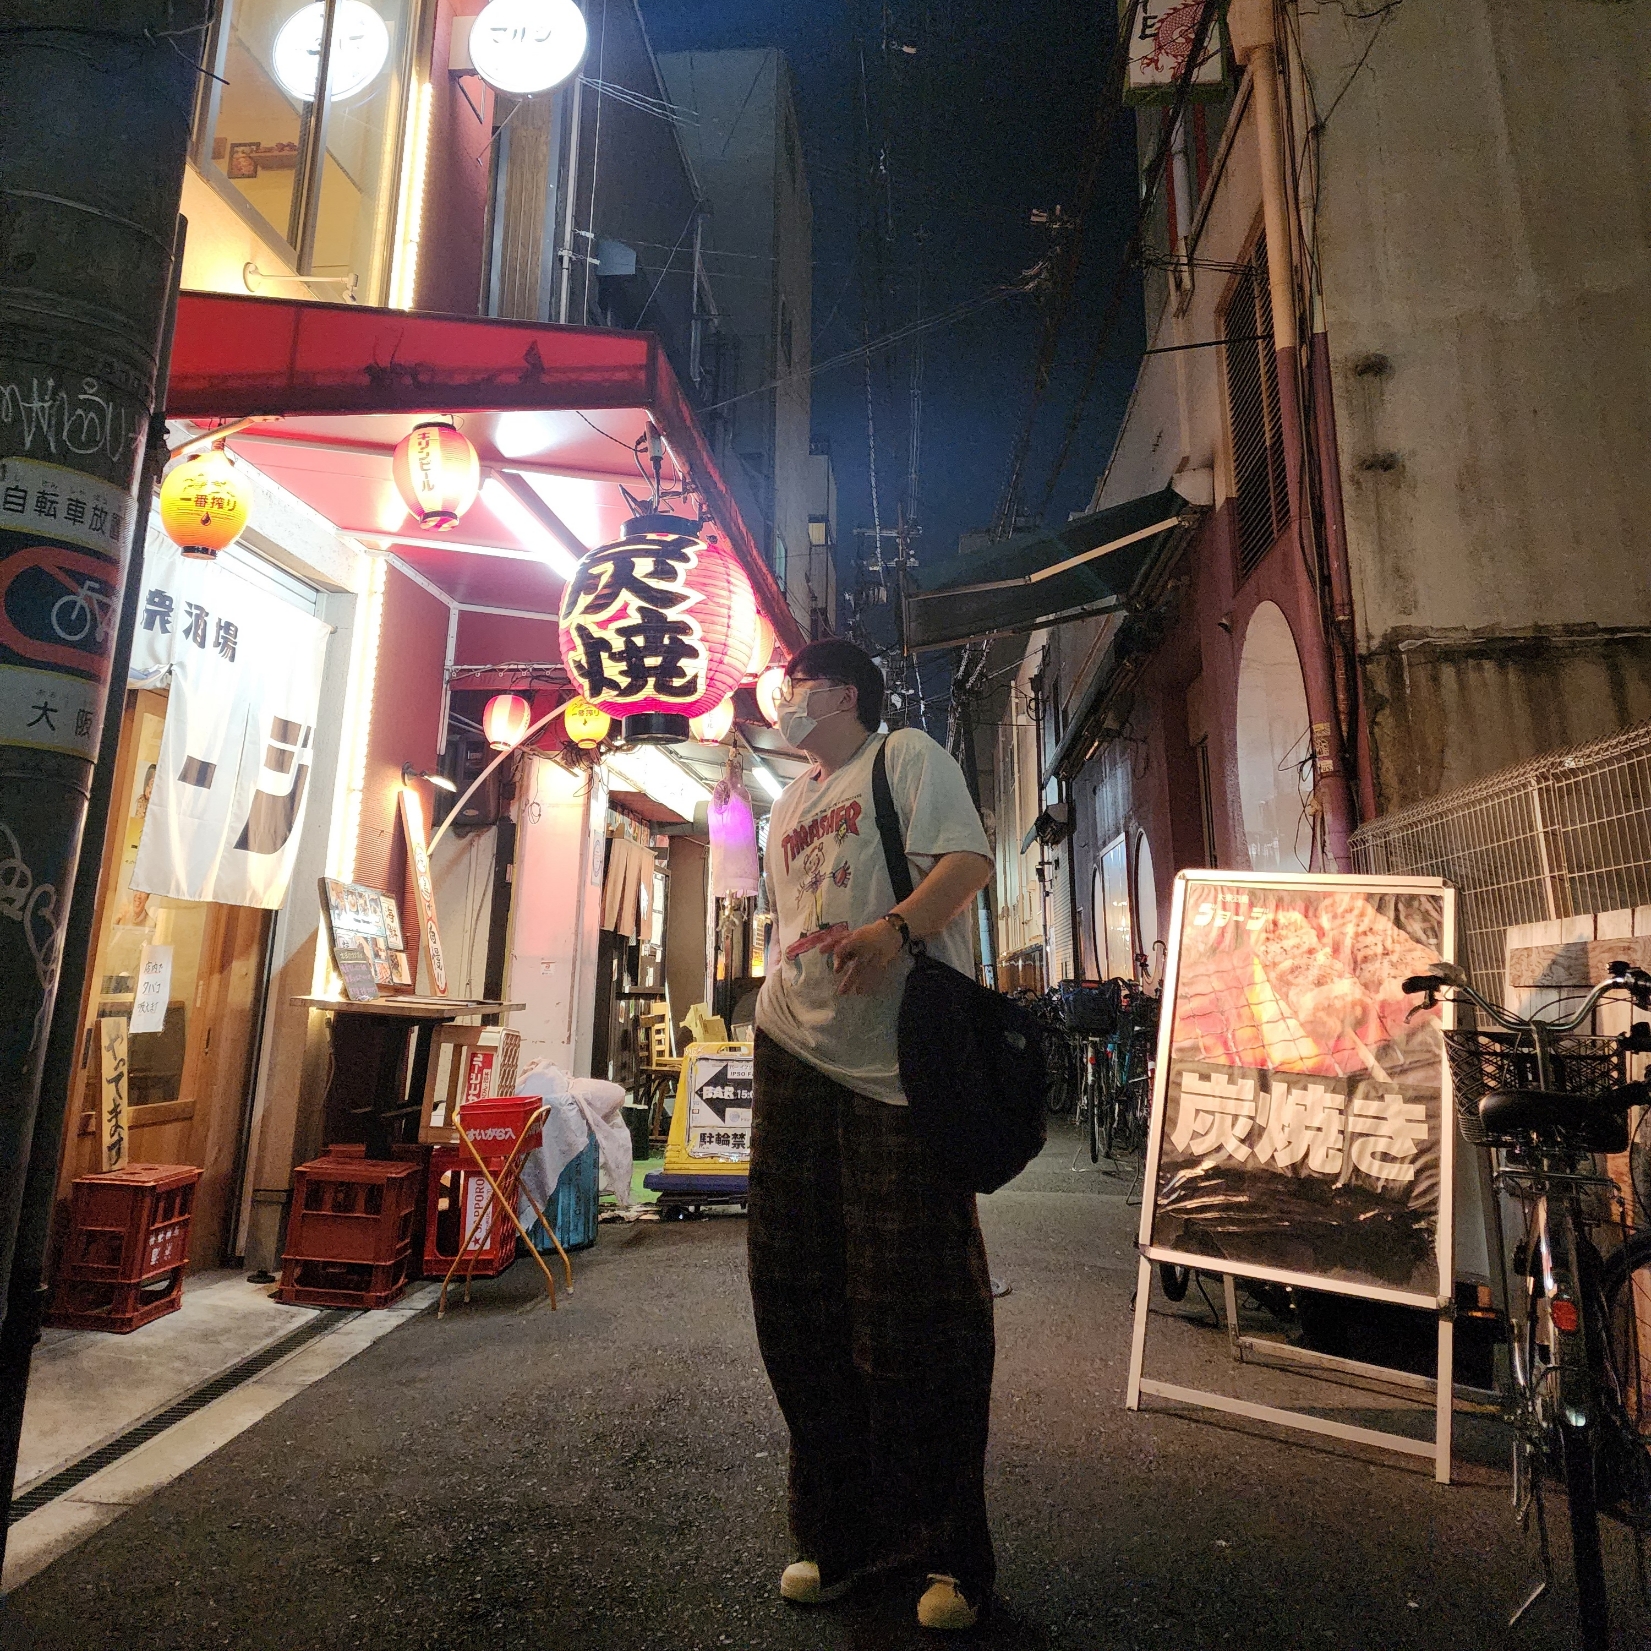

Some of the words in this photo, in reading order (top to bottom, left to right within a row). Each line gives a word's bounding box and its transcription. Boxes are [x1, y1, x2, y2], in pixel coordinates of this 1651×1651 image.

[179, 494, 237, 512] 一番搾り
[781, 800, 862, 876] THRASHER
[142, 981, 161, 995] タバコ
[104, 1020, 126, 1166] やってます
[702, 1086, 735, 1100] BAR
[466, 1128, 516, 1142] すいがら入
[1170, 1070, 1430, 1182] 炭焼き
